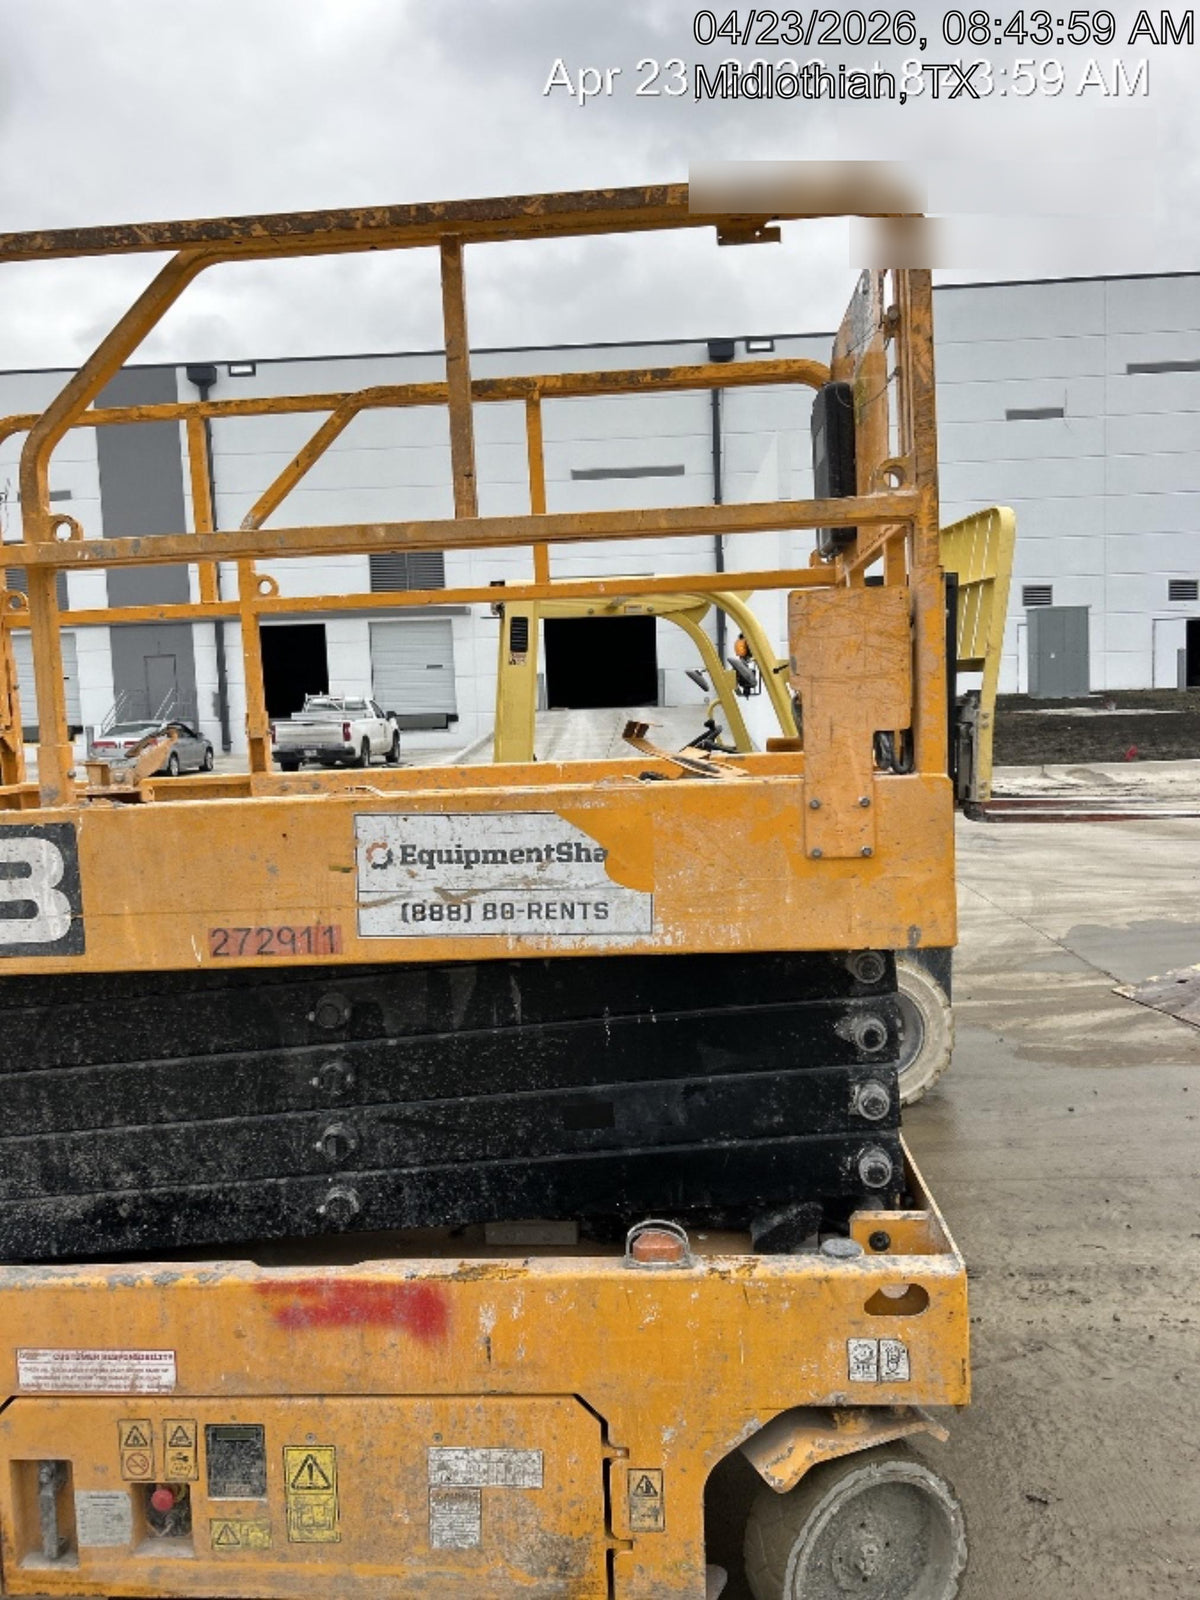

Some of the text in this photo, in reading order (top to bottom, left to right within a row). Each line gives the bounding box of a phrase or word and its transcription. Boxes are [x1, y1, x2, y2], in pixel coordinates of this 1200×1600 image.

[400, 842, 608, 870] EquipmentSha
[401, 901, 609, 923] (888) 80-RENTS
[210, 926, 337, 956] 272911
